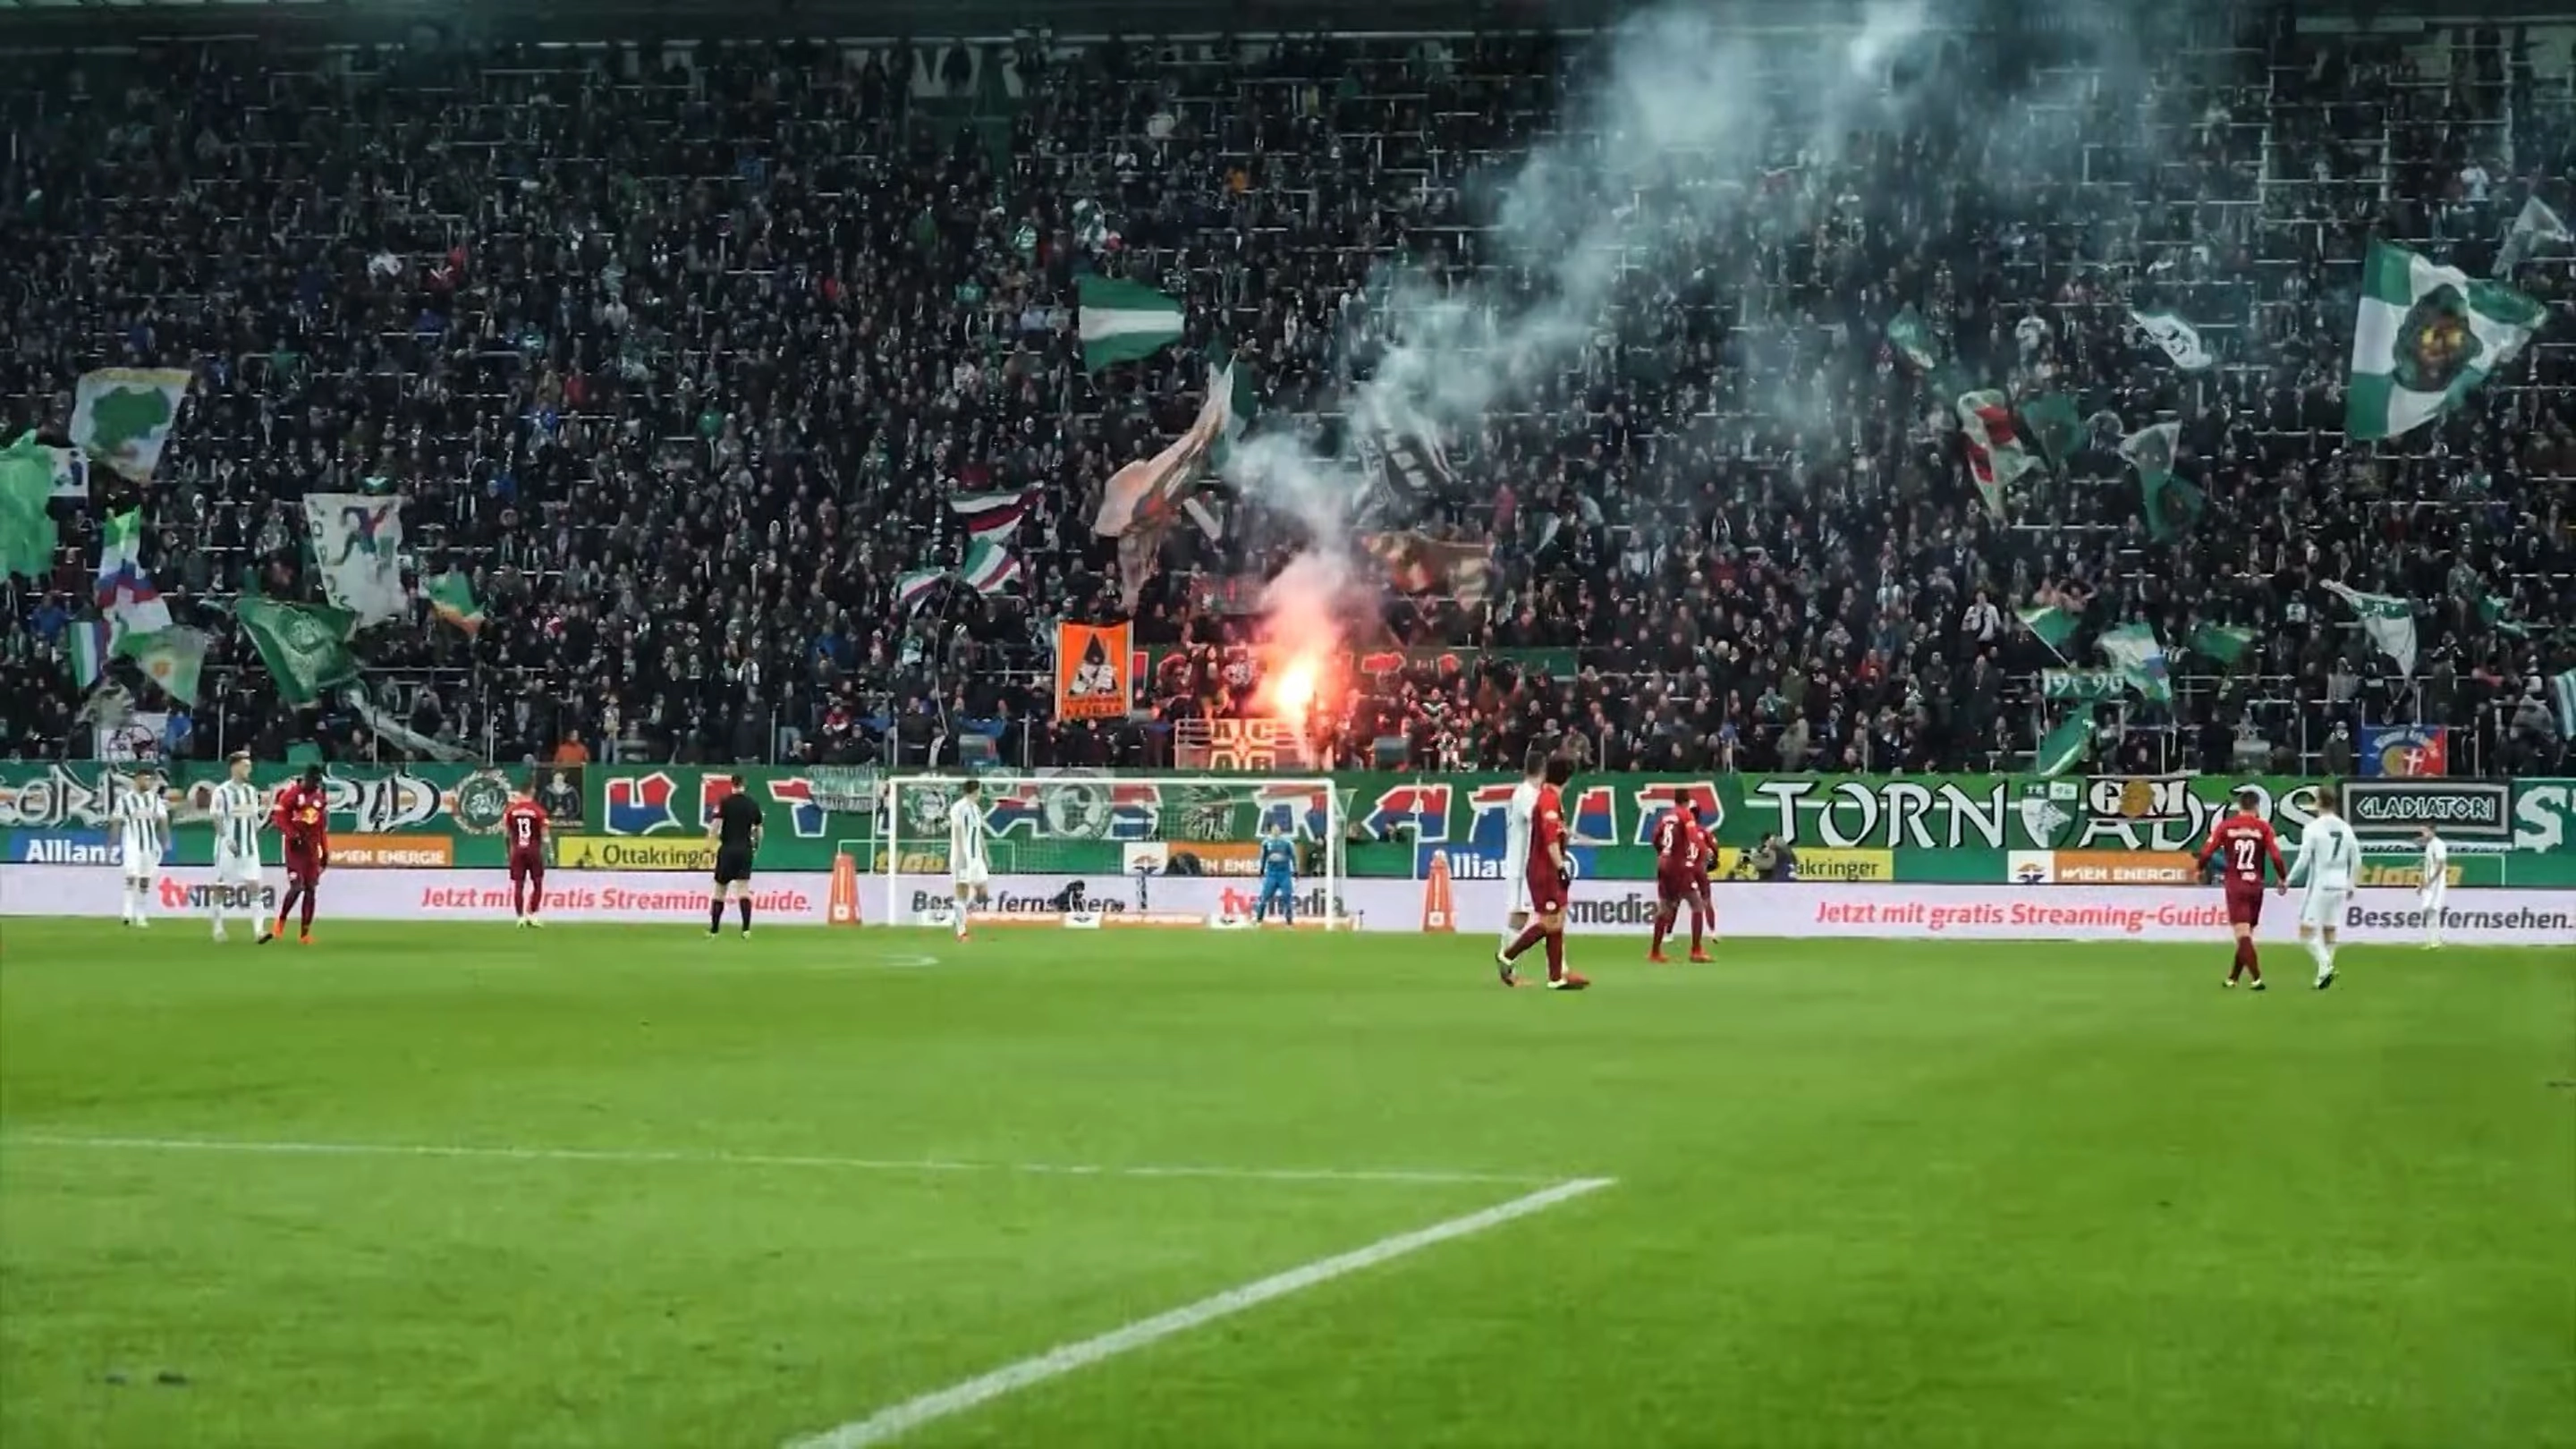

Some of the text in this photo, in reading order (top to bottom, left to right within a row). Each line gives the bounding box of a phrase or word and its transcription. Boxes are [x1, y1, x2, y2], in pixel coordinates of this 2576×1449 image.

[2357, 796, 2496, 820] GLADIATORI
[377, 851, 446, 864] ENERGIE
[2234, 839, 2255, 870] 22
[2329, 831, 2343, 861] 7
[1795, 858, 1880, 882] akringer
[422, 887, 477, 908] Jetzt
[483, 887, 513, 907] mi
[542, 887, 595, 908] ratis
[1570, 894, 1657, 924] media
[1815, 901, 1876, 924] Jetzt
[1882, 902, 1926, 924] mit
[1931, 902, 2003, 930] gratis
[2439, 906, 2574, 929] fernsehen.
